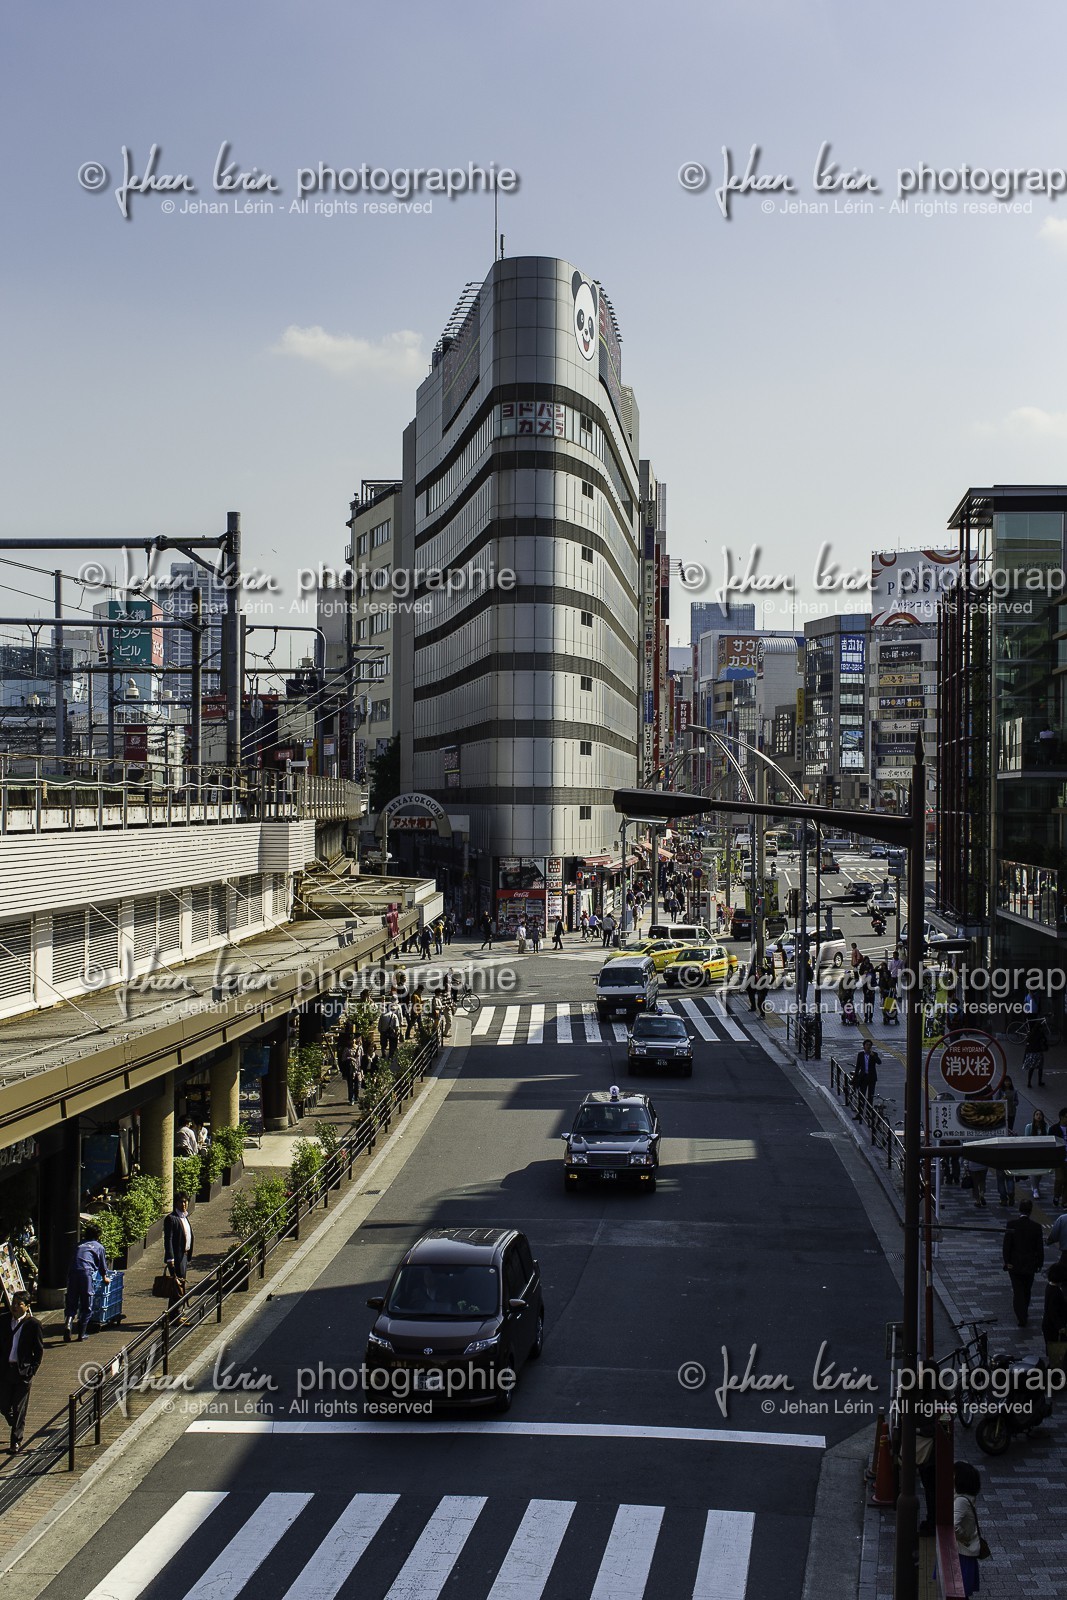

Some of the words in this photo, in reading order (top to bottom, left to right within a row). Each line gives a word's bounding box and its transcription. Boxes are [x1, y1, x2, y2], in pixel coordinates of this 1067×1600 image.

[502, 403, 564, 418] ヨドバシ
[519, 419, 564, 436] カメラ
[113, 627, 150, 639] センター
[392, 817, 433, 829] アメヤ横丁
[945, 1055, 991, 1077] 消火栓
